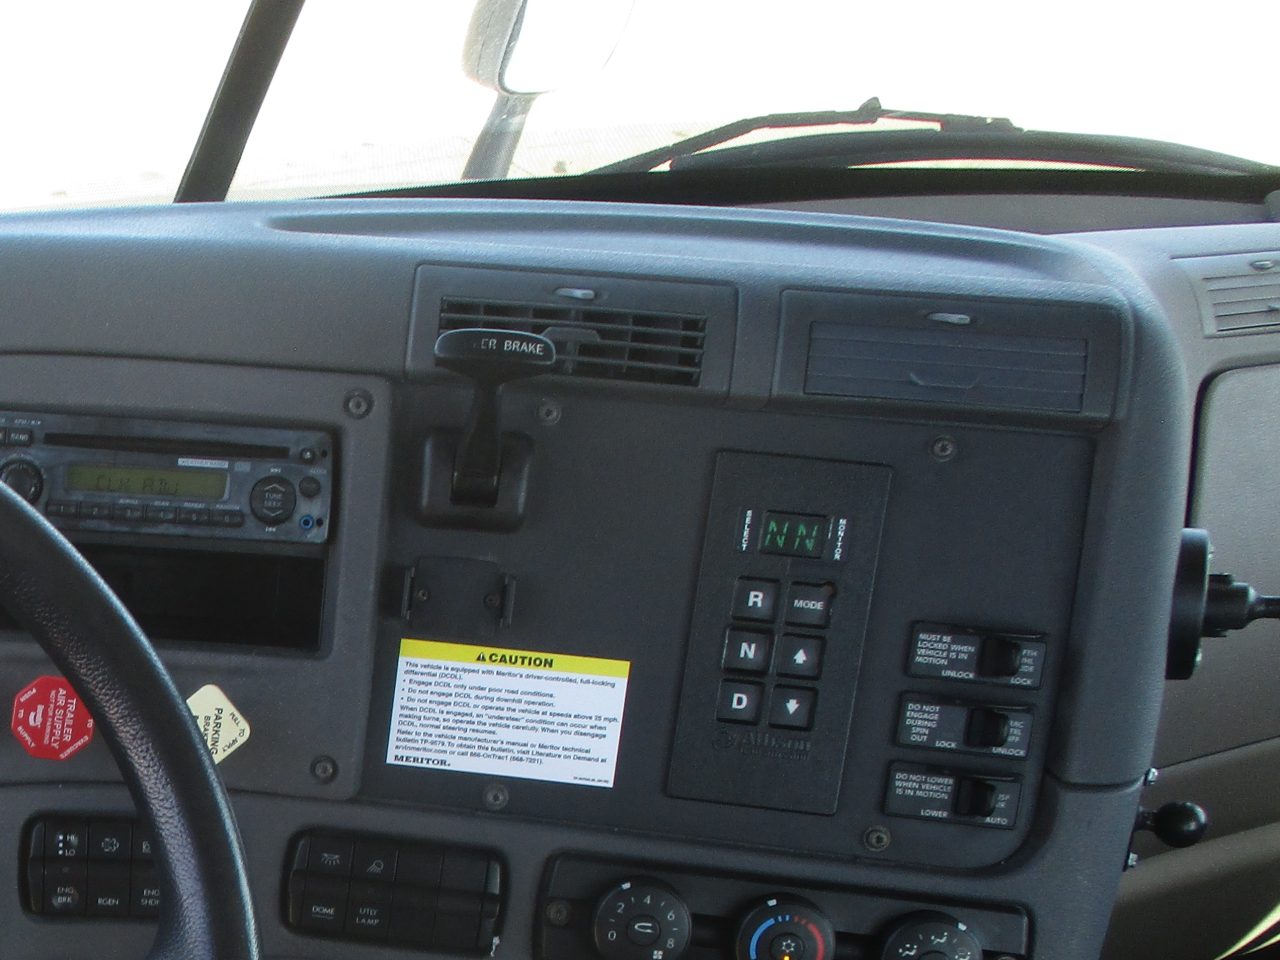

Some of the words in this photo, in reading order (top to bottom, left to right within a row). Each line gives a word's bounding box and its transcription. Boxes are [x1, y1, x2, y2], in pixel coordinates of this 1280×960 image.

[504, 340, 544, 356] BRAKE
[742, 509, 752, 551] SELECT
[833, 518, 847, 560] MONITOR
[747, 591, 764, 608] R
[793, 599, 824, 610] MODE
[739, 642, 756, 660] N
[918, 641, 948, 650] LOCKED
[950, 644, 976, 652] WHEN
[916, 648, 948, 658] VEHICLE
[488, 652, 553, 668] CAUTION
[914, 656, 948, 665] MOTION
[942, 670, 975, 679] UNLOCK
[1010, 676, 1033, 686] LOCK
[56, 688, 66, 706] AIR
[731, 693, 748, 710] D
[63, 698, 76, 742] TRAILER
[906, 710, 939, 720] ENGAGE
[203, 716, 211, 741] BRAK
[906, 718, 937, 728] DURING
[51, 709, 64, 750] SUPPLY
[210, 708, 224, 755] PARKING
[910, 734, 928, 742] OUT
[936, 740, 958, 748] LOCK
[992, 746, 1026, 756] UNLOCK
[896, 772, 908, 780] DO
[909, 774, 926, 782] NOT
[927, 776, 954, 784] LOWER
[895, 780, 920, 788] WHEN
[921, 784, 952, 792] VEHICLE
[916, 790, 948, 800] MOTION
[920, 809, 948, 818] LOWER
[985, 816, 1008, 825] AUTO
[643, 895, 651, 904] 4
[312, 904, 334, 914] DOME
[616, 902, 625, 914] 2
[667, 910, 675, 920] 6
[666, 938, 674, 949] 8
